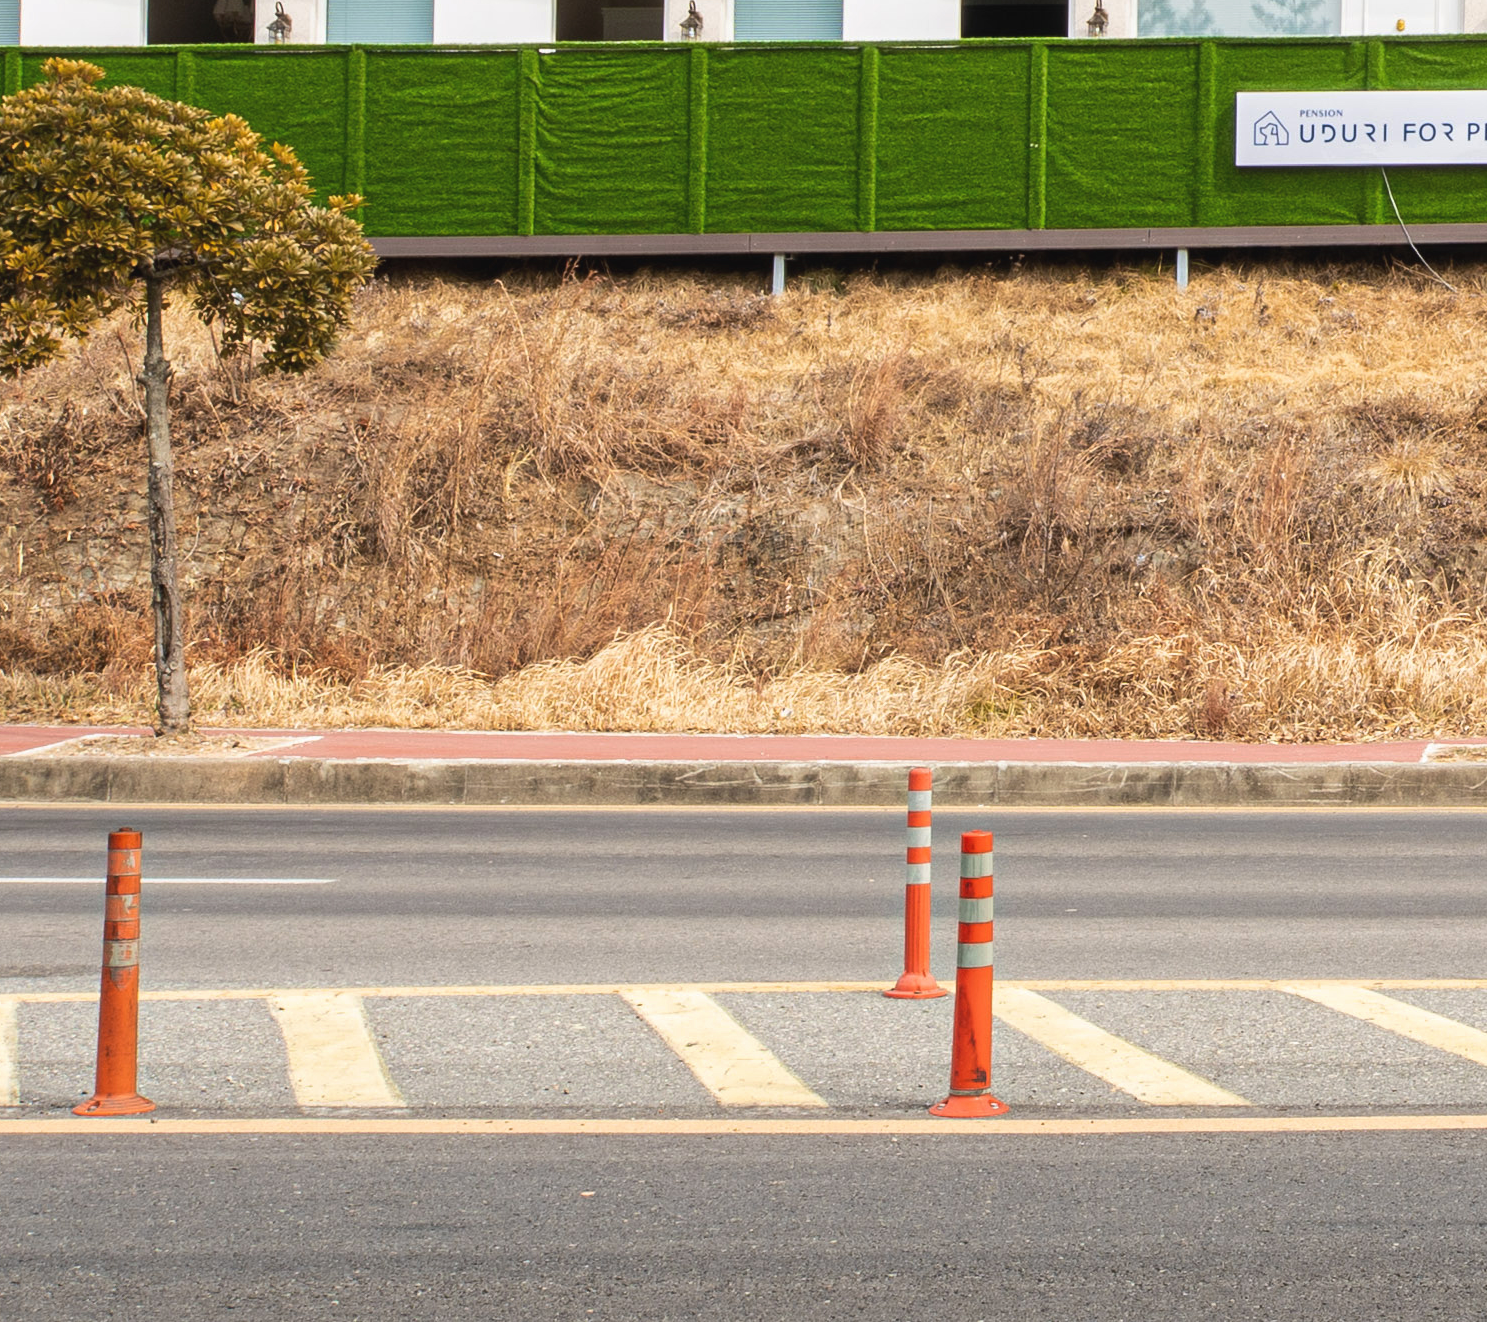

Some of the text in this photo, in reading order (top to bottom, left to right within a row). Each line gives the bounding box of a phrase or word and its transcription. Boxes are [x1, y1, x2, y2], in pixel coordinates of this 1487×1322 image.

[1300, 109, 1343, 117] PENSION
[1300, 123, 1387, 143] UDURI
[1403, 122, 1454, 142] FOR
